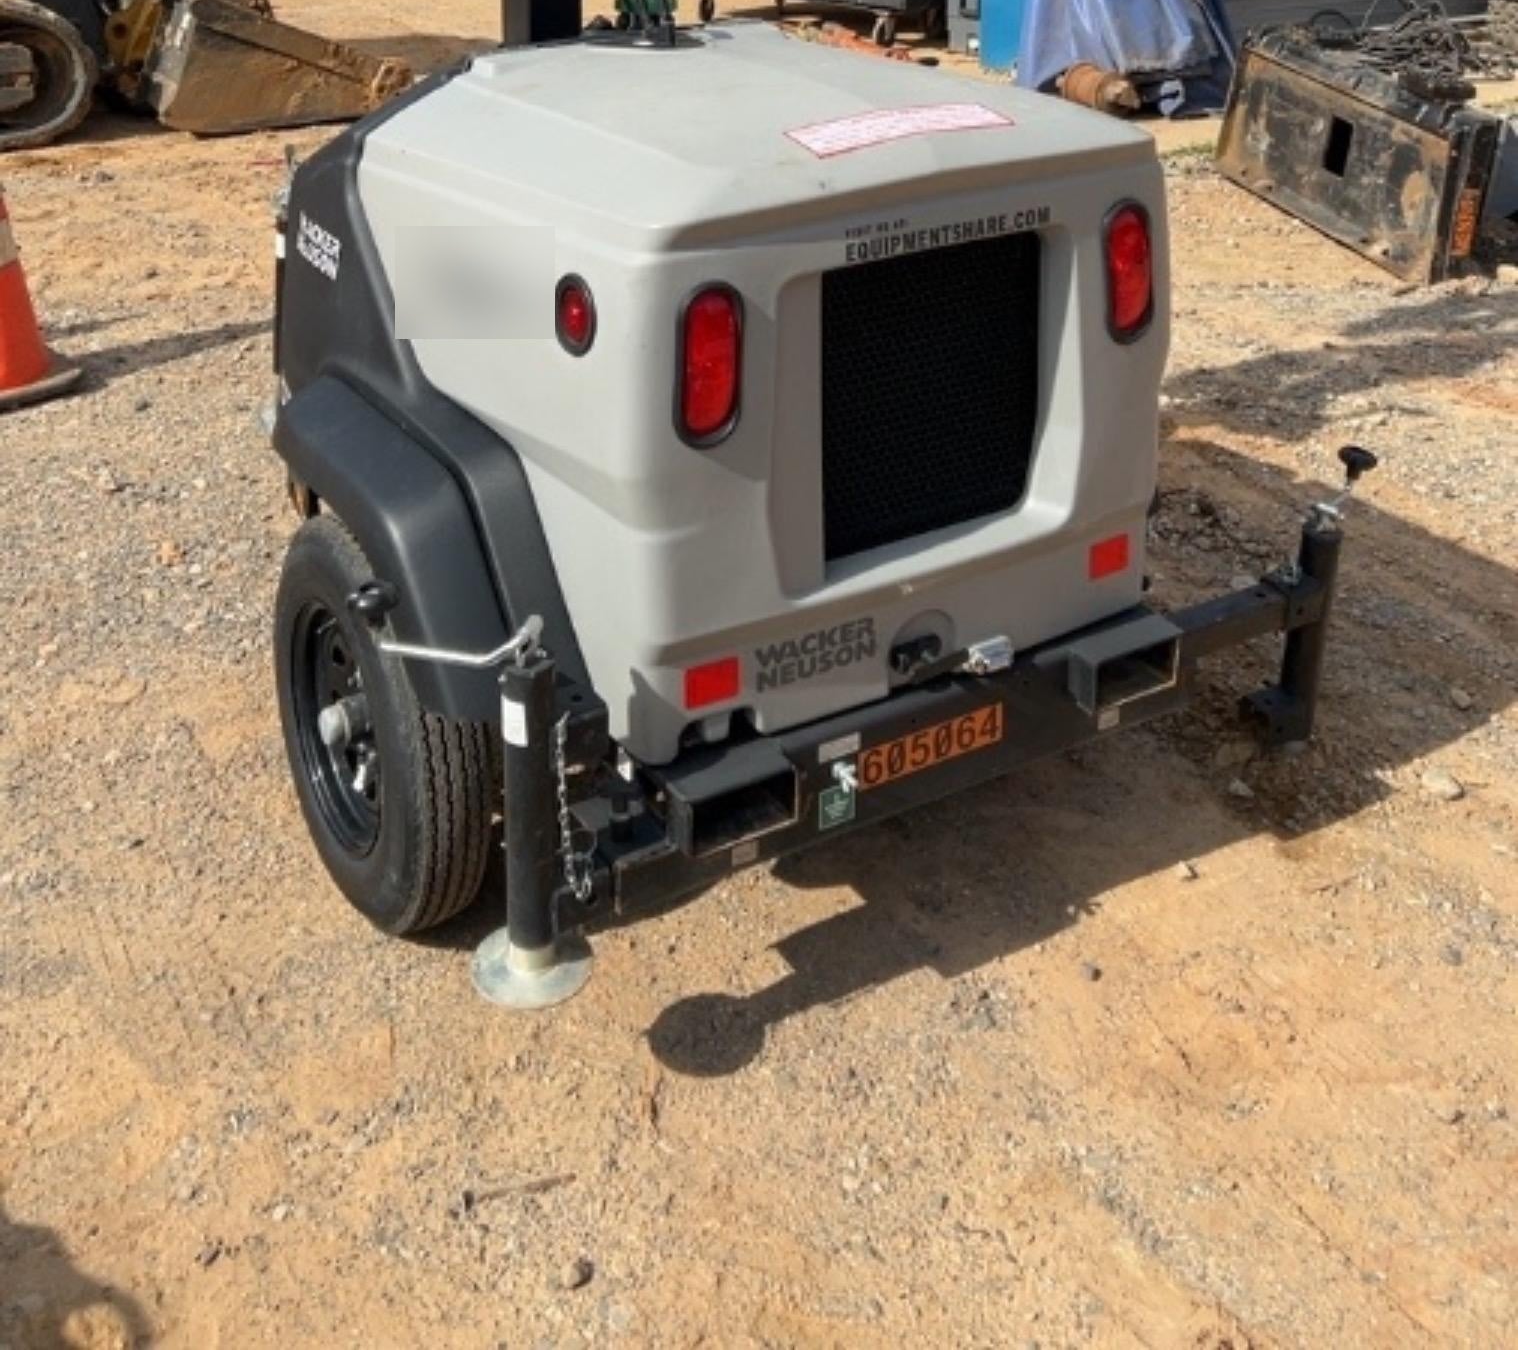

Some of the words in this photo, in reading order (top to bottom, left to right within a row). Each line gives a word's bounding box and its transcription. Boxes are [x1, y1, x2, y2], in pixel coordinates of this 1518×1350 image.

[755, 617, 875, 666] WACKER
[756, 642, 876, 693] NEUSON
[863, 705, 1000, 784] 605064
